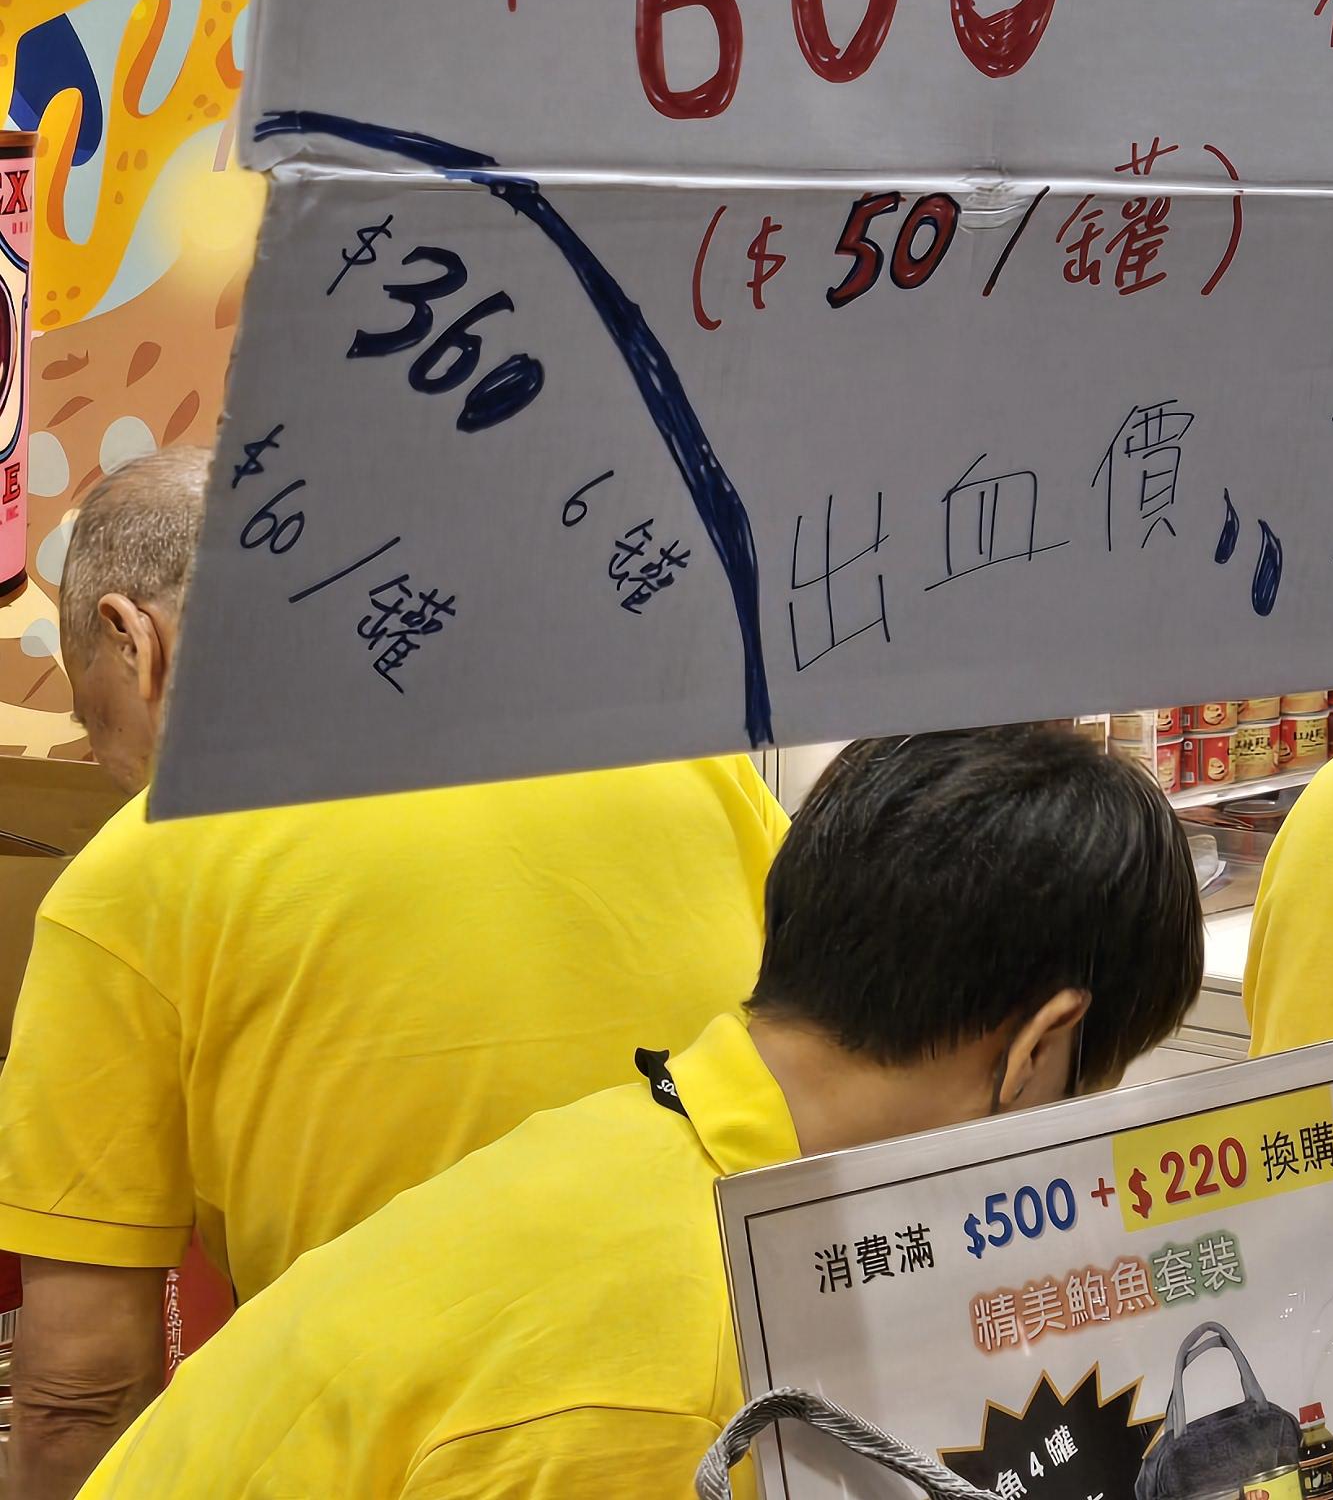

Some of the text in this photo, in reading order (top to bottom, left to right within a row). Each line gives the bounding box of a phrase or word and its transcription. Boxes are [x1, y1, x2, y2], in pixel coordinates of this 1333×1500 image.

[814, 1222, 936, 1293] 消費滿
[963, 1177, 1077, 1259] $500
[1128, 1135, 1249, 1220] $220
[974, 1234, 1242, 1353] 精美鮑魚套裝
